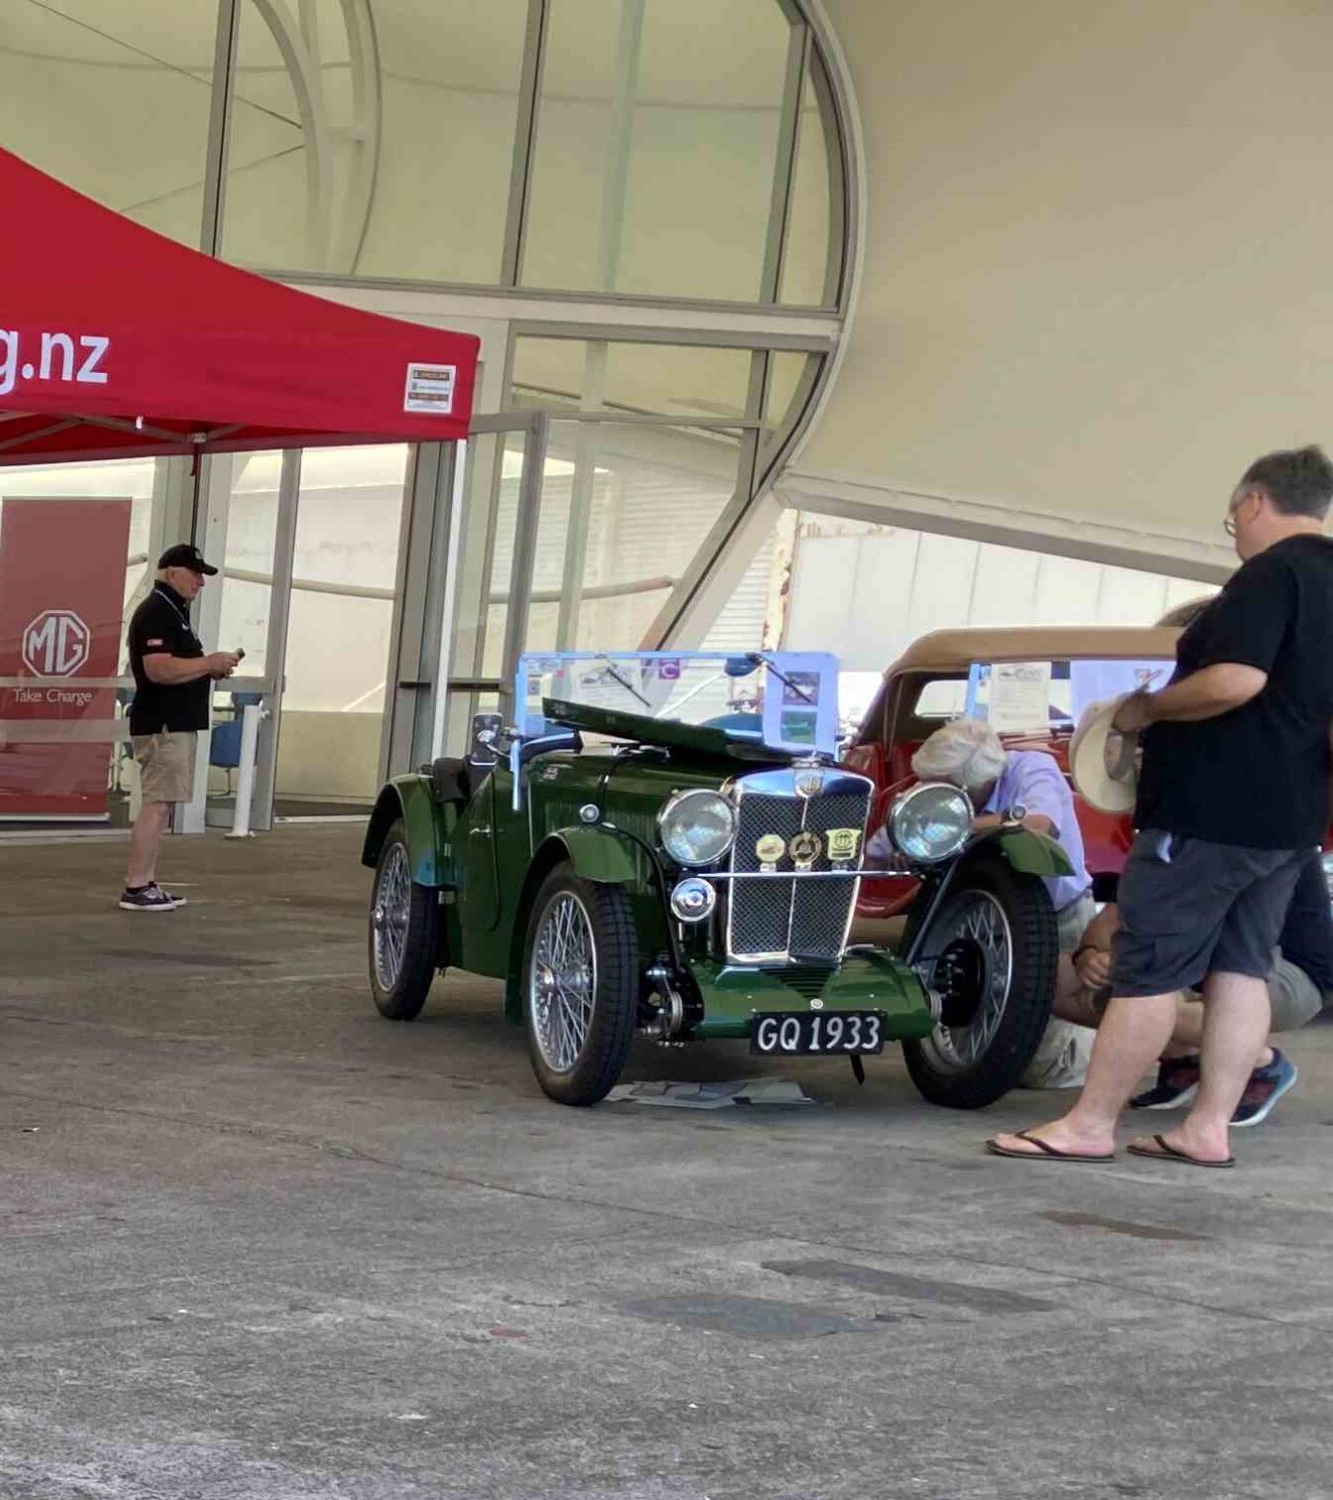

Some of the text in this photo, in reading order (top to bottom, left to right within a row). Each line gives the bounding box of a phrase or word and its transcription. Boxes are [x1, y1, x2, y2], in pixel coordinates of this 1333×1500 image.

[27, 616, 84, 673] MG
[13, 687, 93, 706] Take Charge
[757, 1016, 881, 1051] GQ 1933
